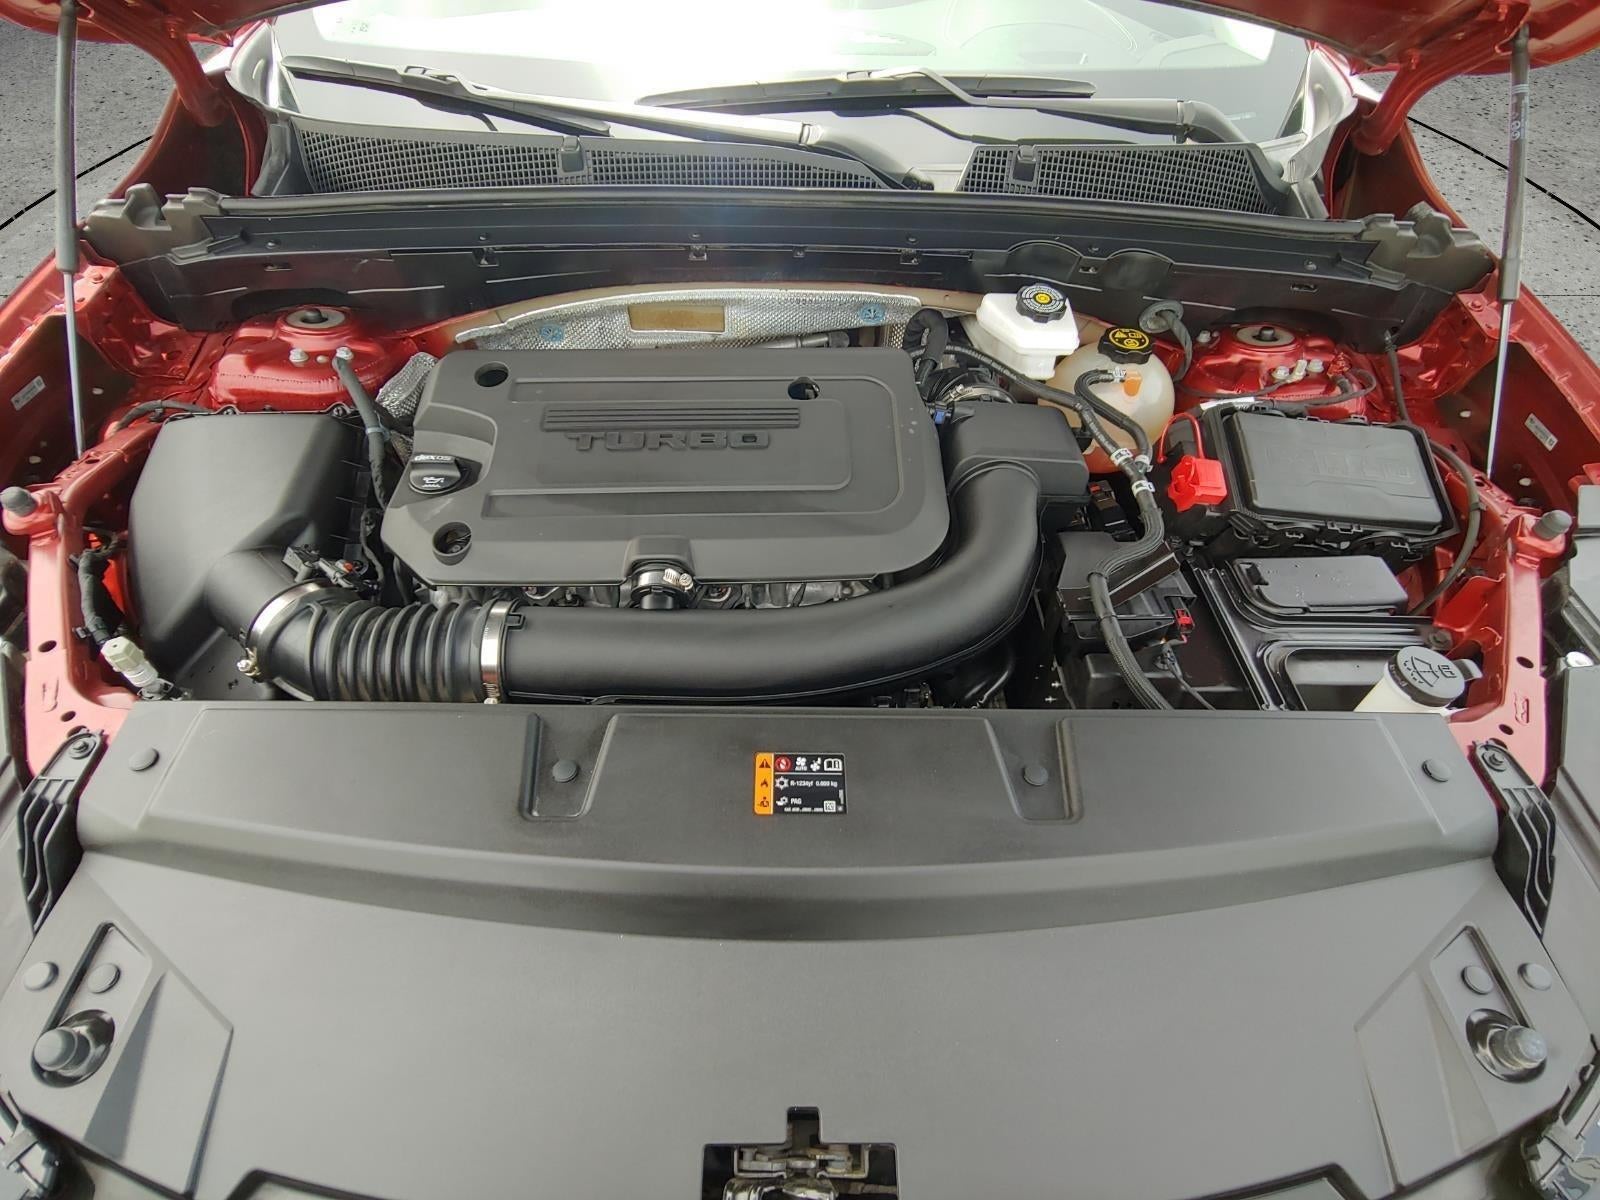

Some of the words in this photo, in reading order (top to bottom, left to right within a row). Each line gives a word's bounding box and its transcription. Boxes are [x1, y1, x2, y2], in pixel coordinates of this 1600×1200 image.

[565, 431, 770, 451] TURBO
[831, 780, 838, 788] kg
[790, 797, 802, 805] PAG
